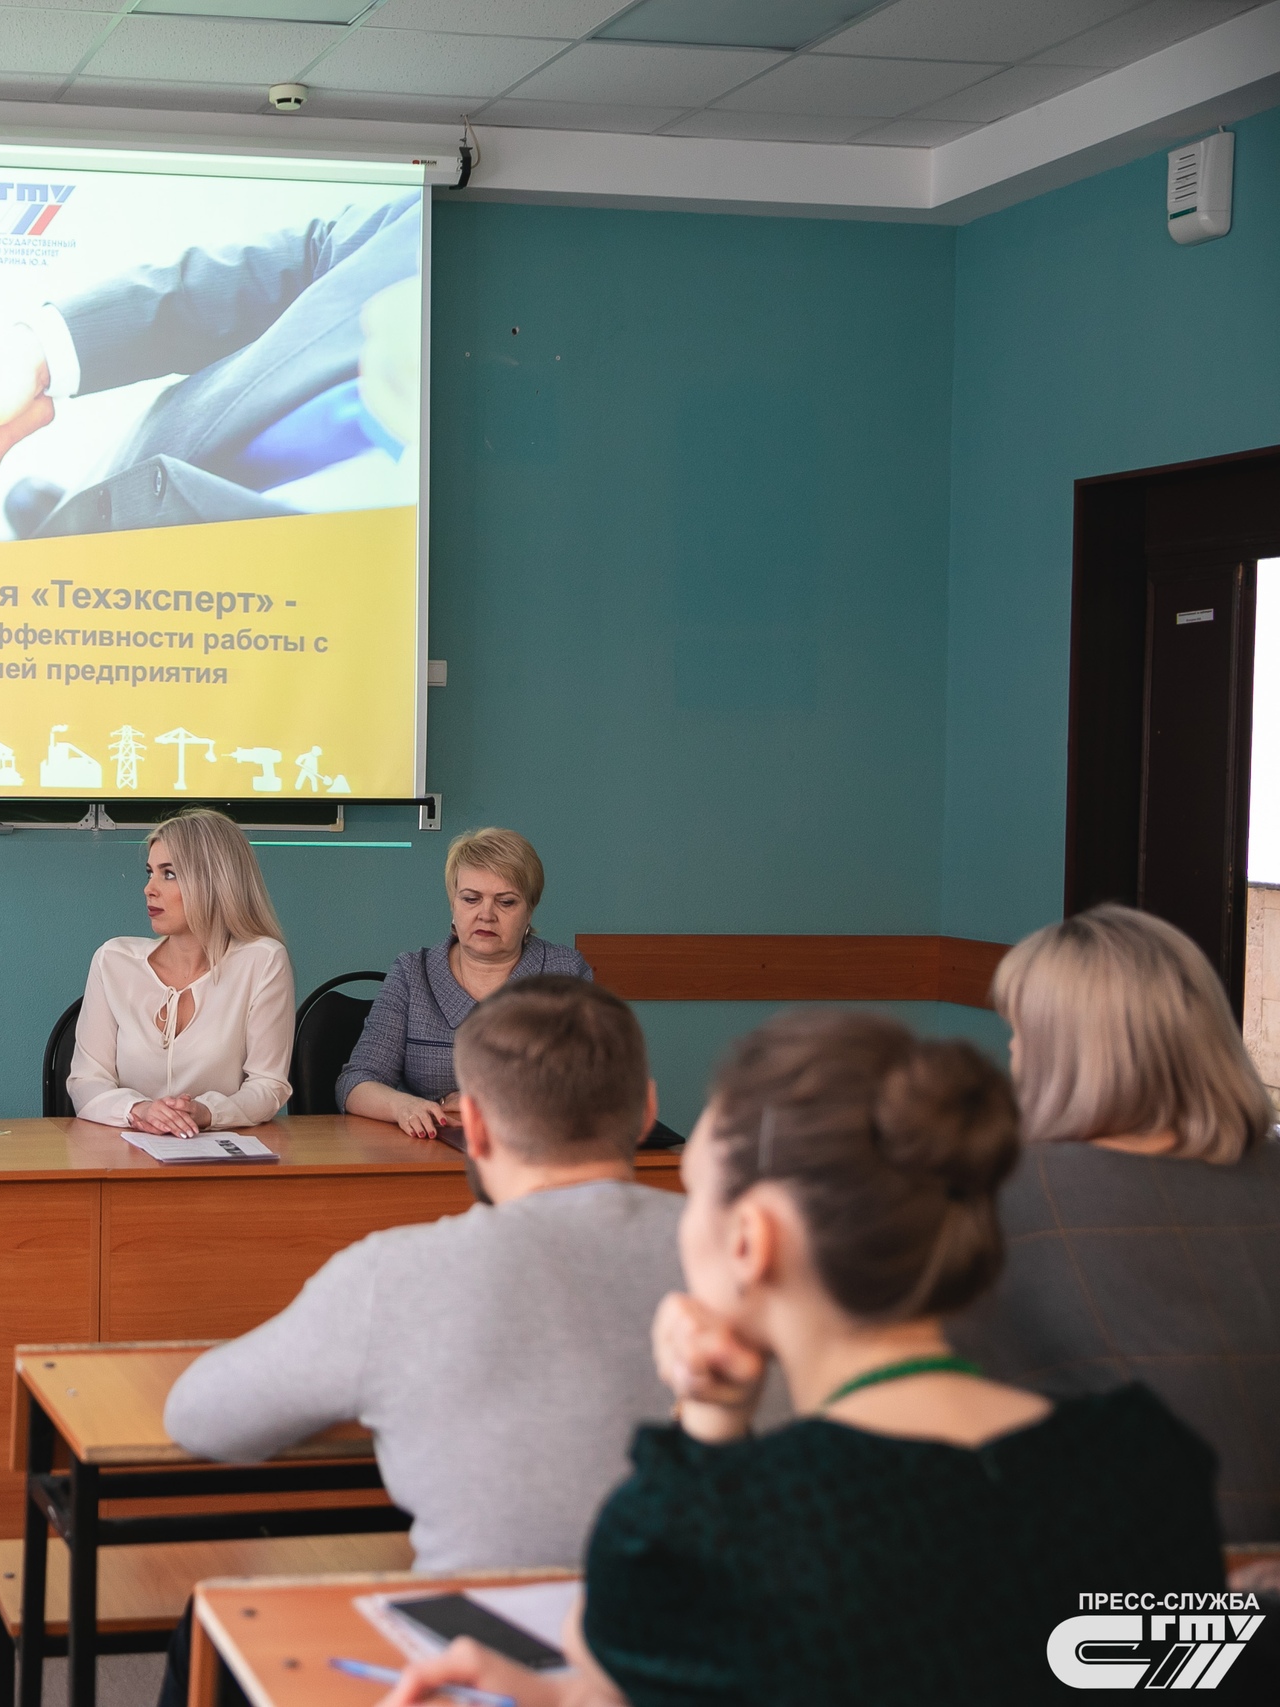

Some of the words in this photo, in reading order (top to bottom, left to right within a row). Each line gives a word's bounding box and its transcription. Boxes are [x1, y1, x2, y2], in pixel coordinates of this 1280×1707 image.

[3, 247, 60, 257] УНИВЕРСИТЕТ
[31, 579, 274, 620] «Техэксперт»
[204, 628, 305, 655] работы
[313, 636, 329, 653] с
[46, 663, 228, 688] предприятия
